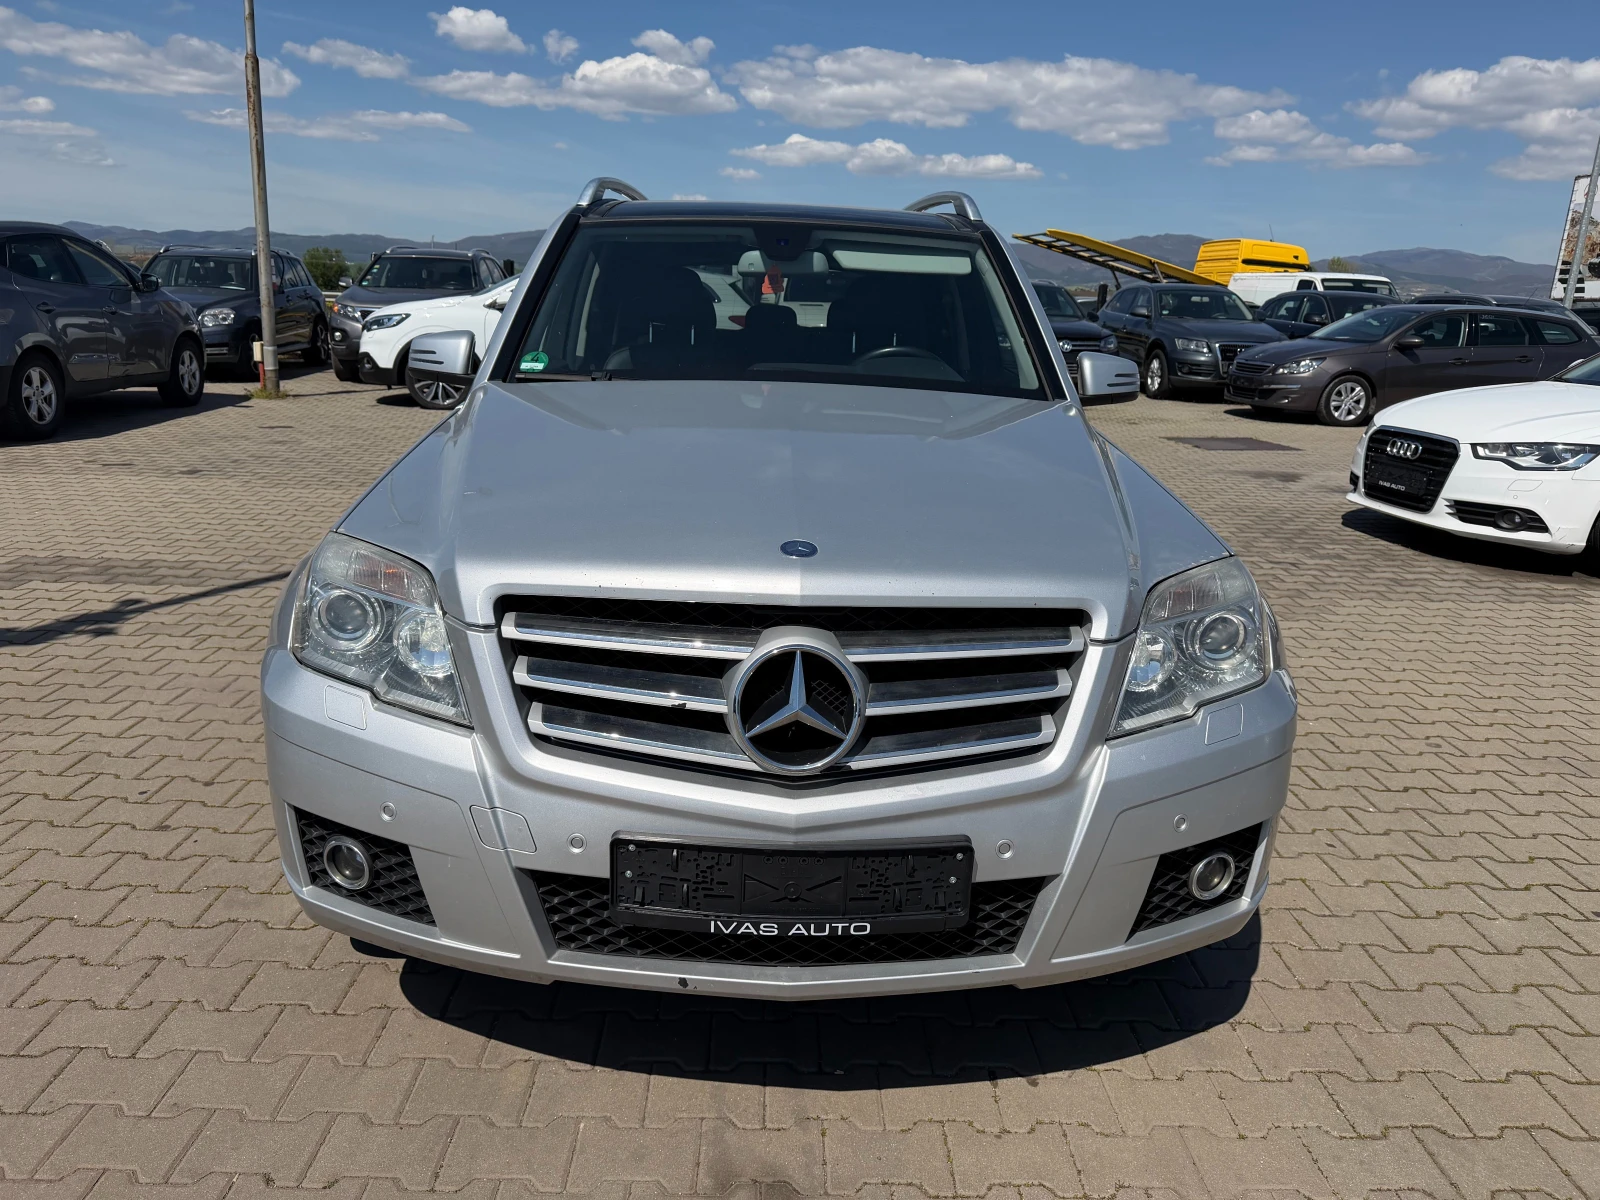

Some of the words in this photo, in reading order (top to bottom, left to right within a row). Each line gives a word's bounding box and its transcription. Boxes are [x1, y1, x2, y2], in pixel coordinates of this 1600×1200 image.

[530, 352, 540, 363] 4
[1390, 483, 1405, 491] AUTO
[710, 920, 779, 936] IVAS
[787, 922, 871, 936] AUTO
